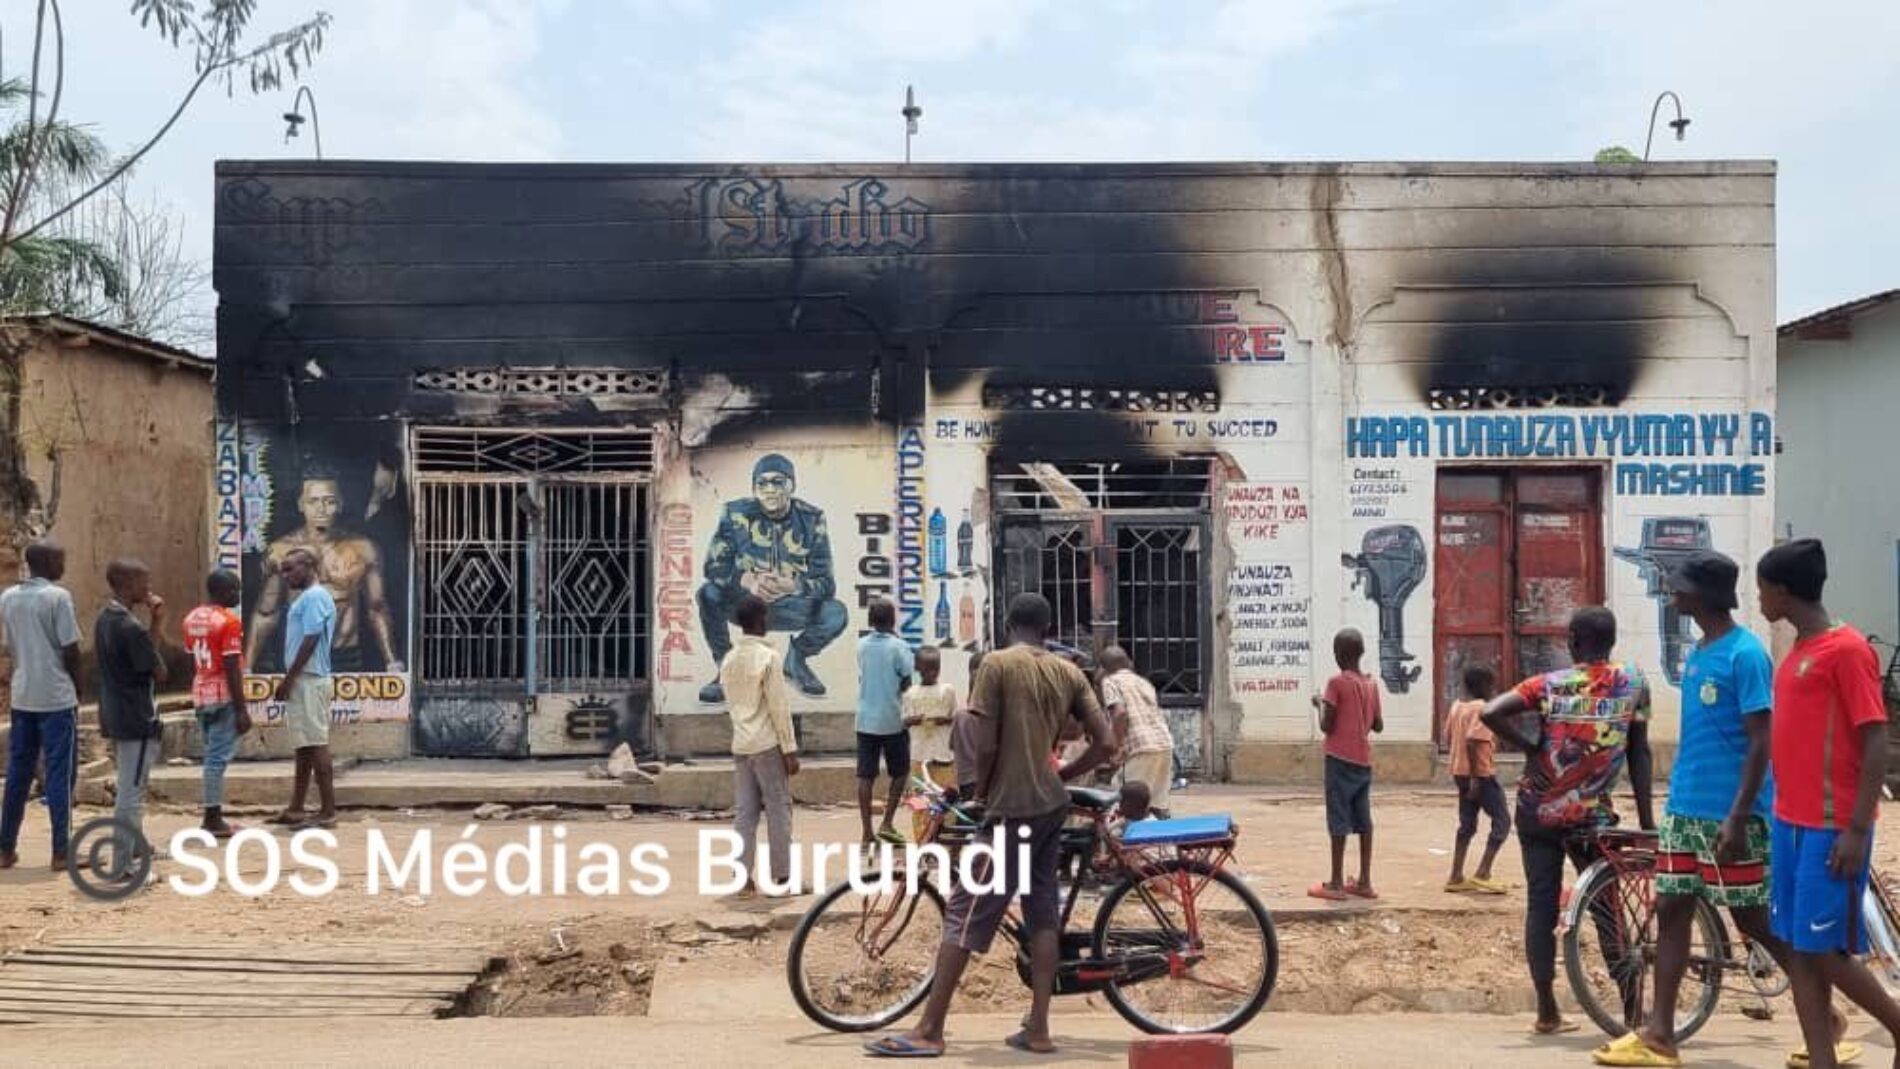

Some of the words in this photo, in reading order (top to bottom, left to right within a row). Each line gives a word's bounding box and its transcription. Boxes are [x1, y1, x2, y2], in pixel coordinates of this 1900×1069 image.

[936, 420, 958, 439] BE
[1207, 420, 1278, 438] SUCCED
[1347, 416, 1429, 458] HAPA
[1433, 415, 1576, 457] TUNAUZA
[1616, 463, 1766, 496] MASHINE
[1243, 523, 1279, 540] KIKE
[242, 675, 405, 702] DIOND
